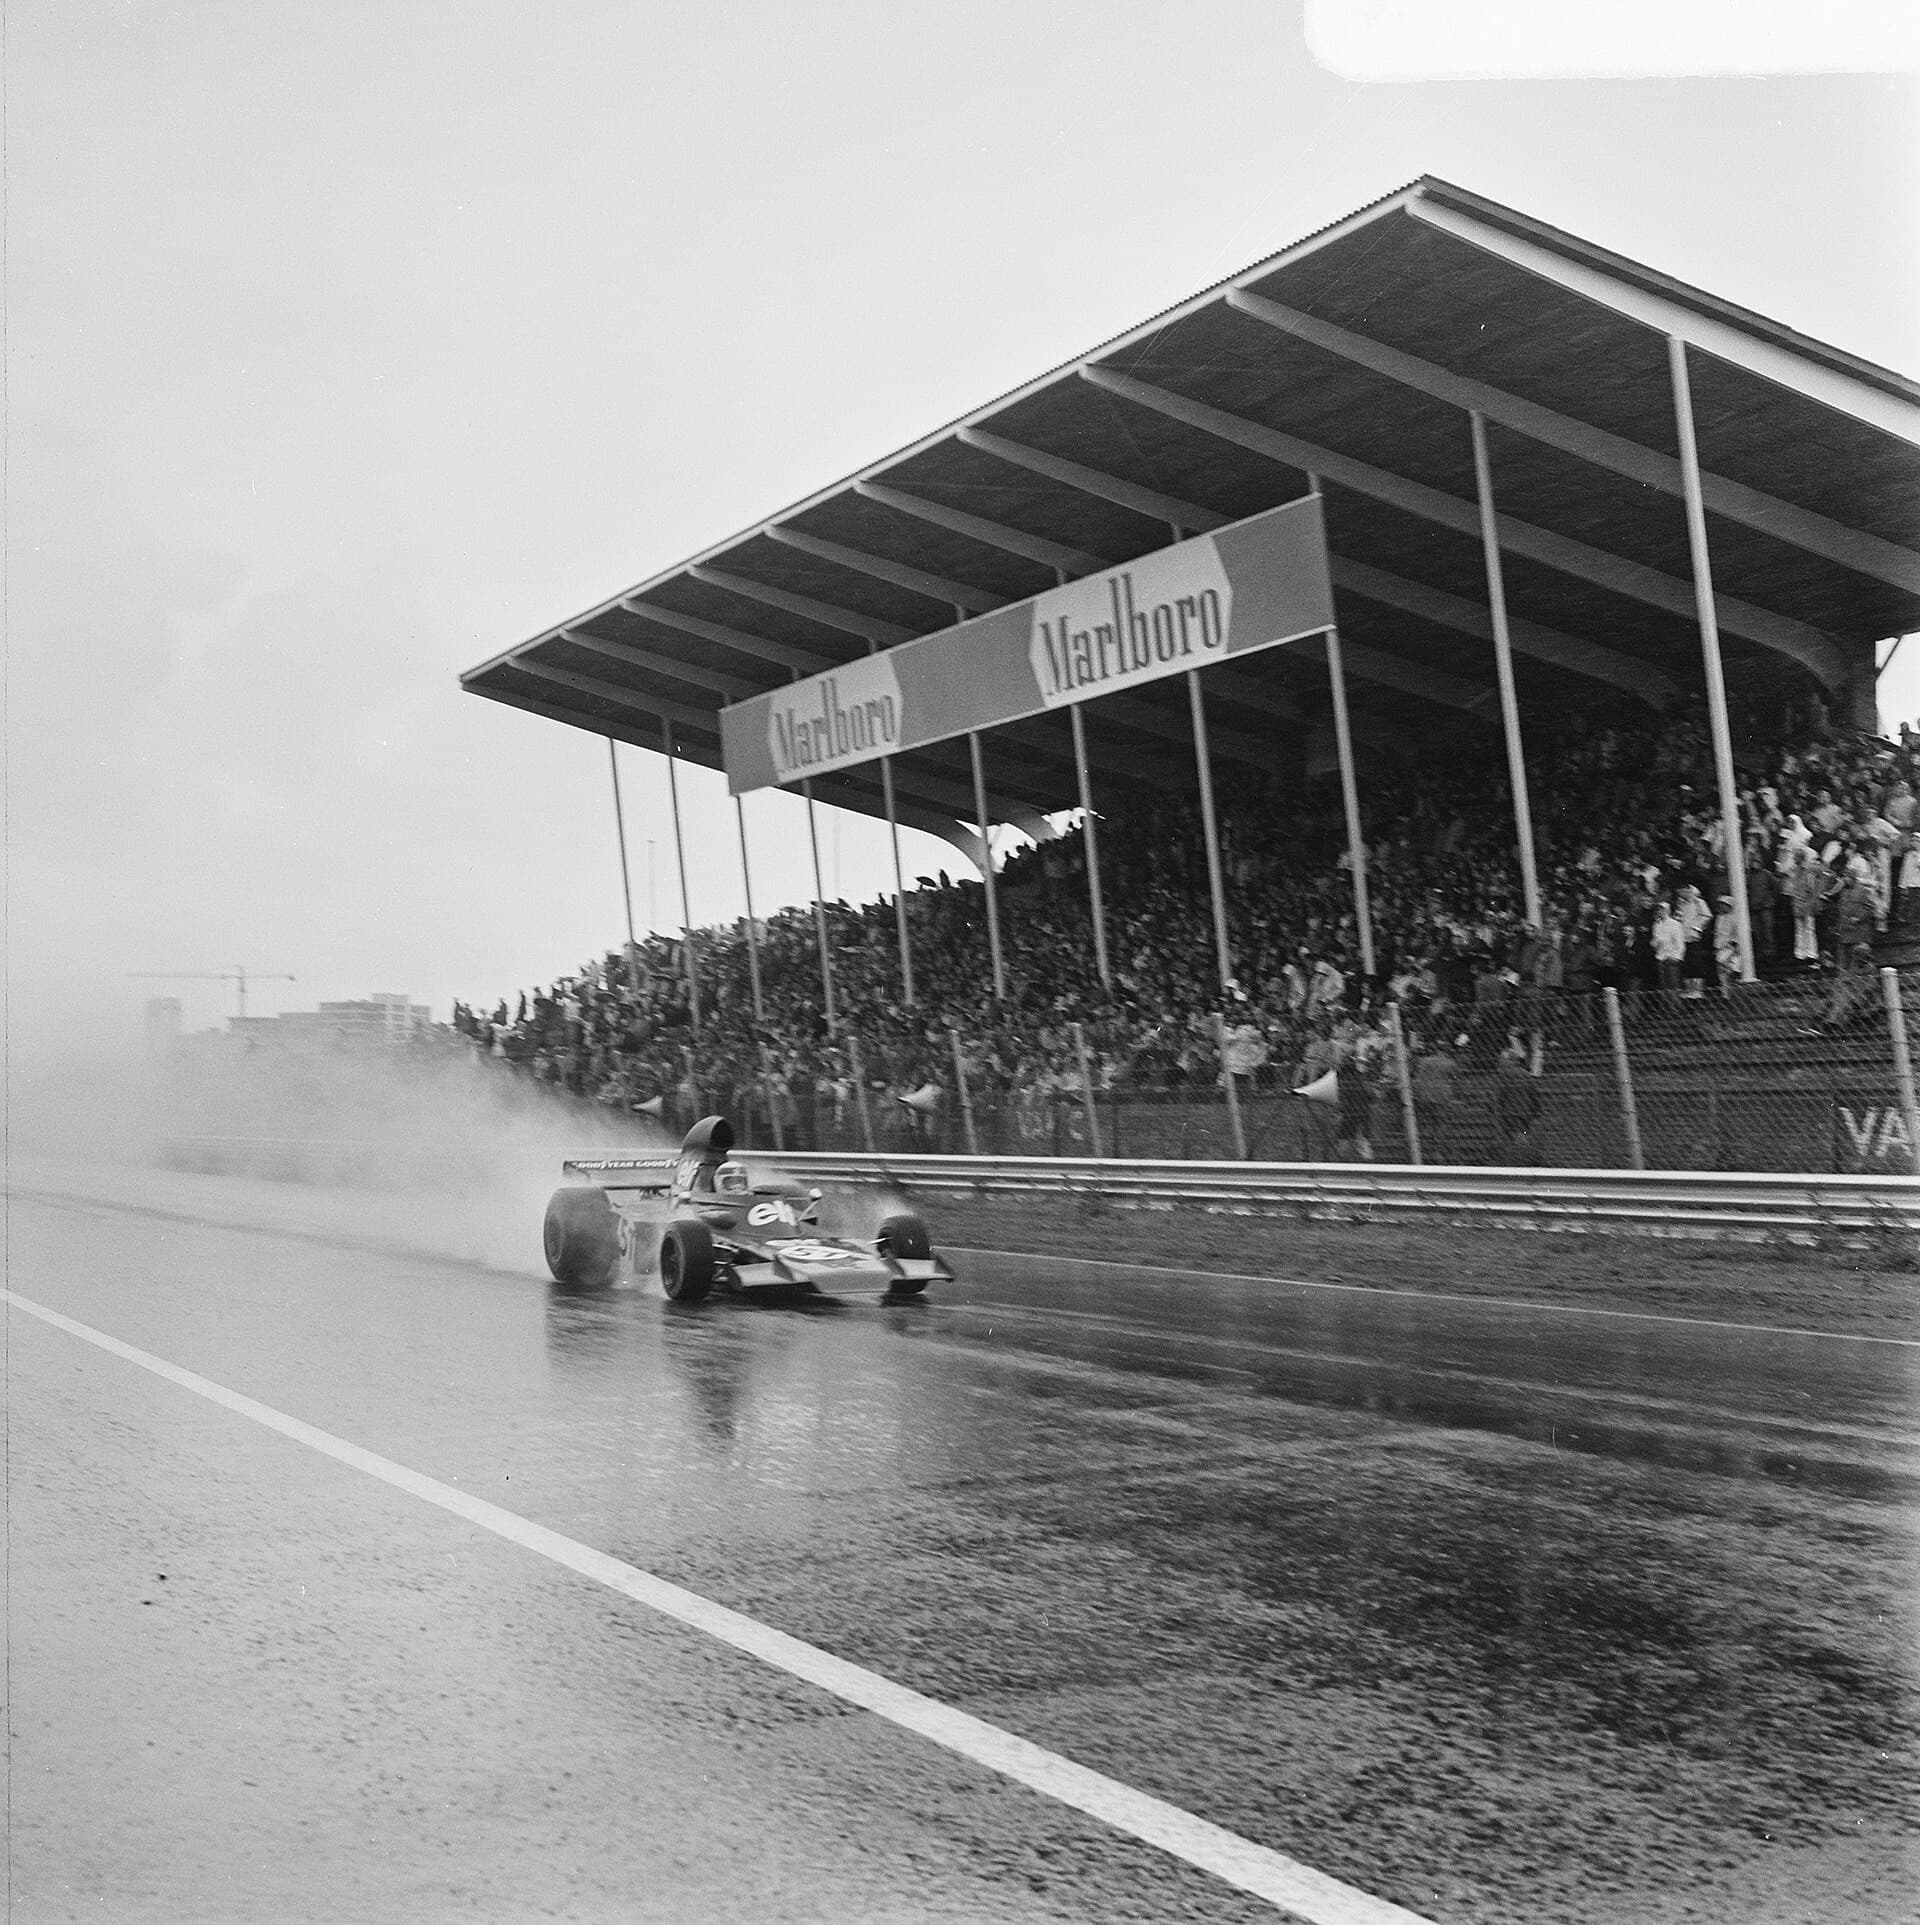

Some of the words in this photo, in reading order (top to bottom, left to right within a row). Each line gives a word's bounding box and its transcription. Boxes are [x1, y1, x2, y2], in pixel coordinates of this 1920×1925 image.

[1040, 572, 1222, 696] Marlboro
[774, 678, 895, 773] Marlboro
[635, 1159, 679, 1169] GOODY
[1838, 1106, 1919, 1157] VA
